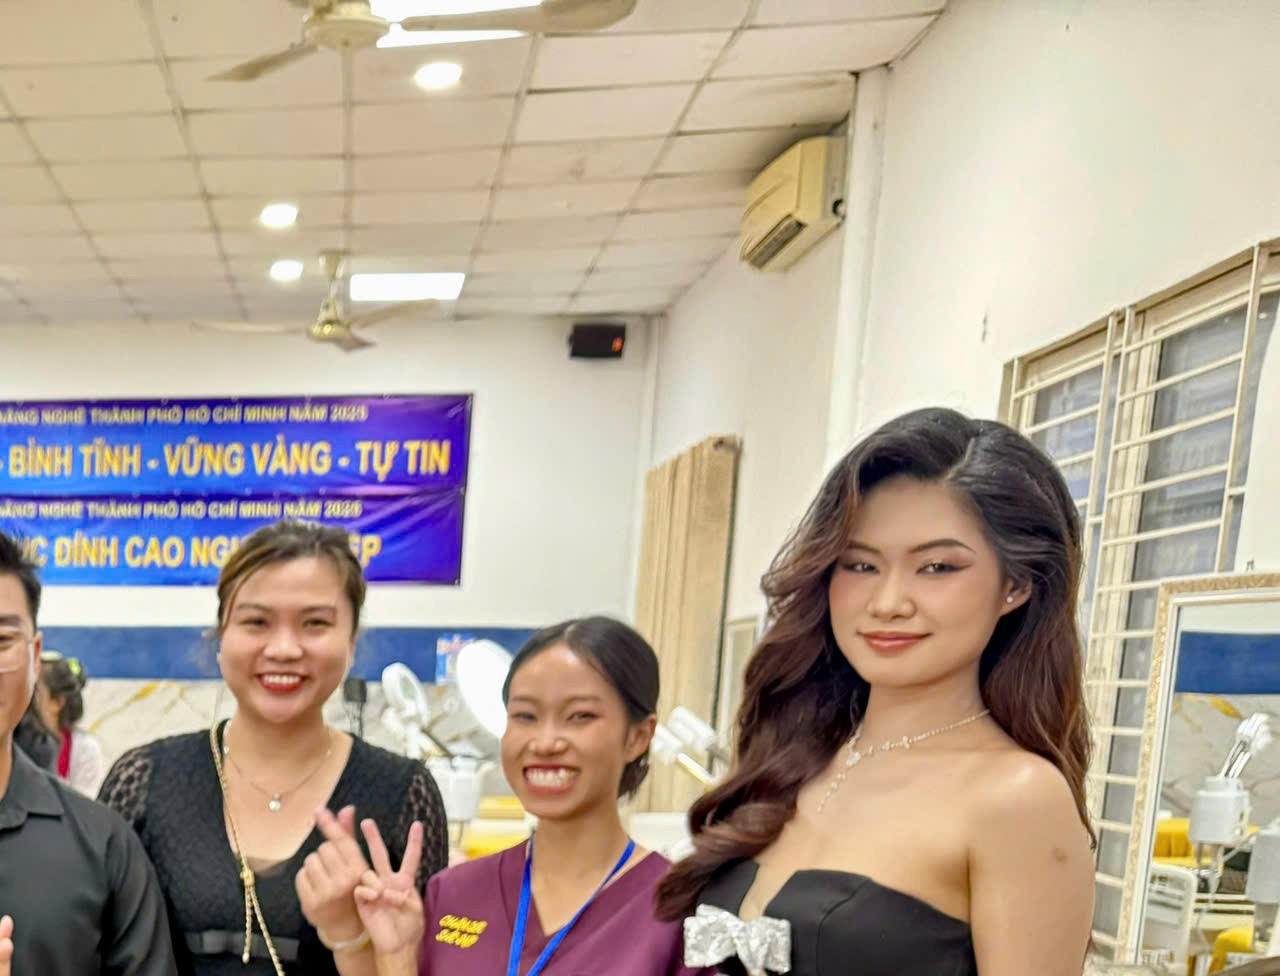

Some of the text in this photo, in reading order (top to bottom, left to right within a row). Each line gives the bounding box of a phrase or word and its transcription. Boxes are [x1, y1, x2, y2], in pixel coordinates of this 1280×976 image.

[91, 404, 145, 424] THÀNH
[147, 405, 183, 424] PHỐ
[212, 403, 241, 424] CHÍ
[244, 405, 285, 423] MINH
[289, 402, 328, 422] NĂM
[9, 436, 73, 477] BÌNH
[80, 436, 141, 477] TĨNH
[164, 435, 245, 476] VỮNG
[252, 433, 332, 476] VÀNG
[355, 441, 400, 483] TỰ
[404, 440, 452, 475] TIN
[208, 499, 237, 519] CHÍ
[239, 501, 280, 518] MINH
[124, 535, 185, 568] CAO
